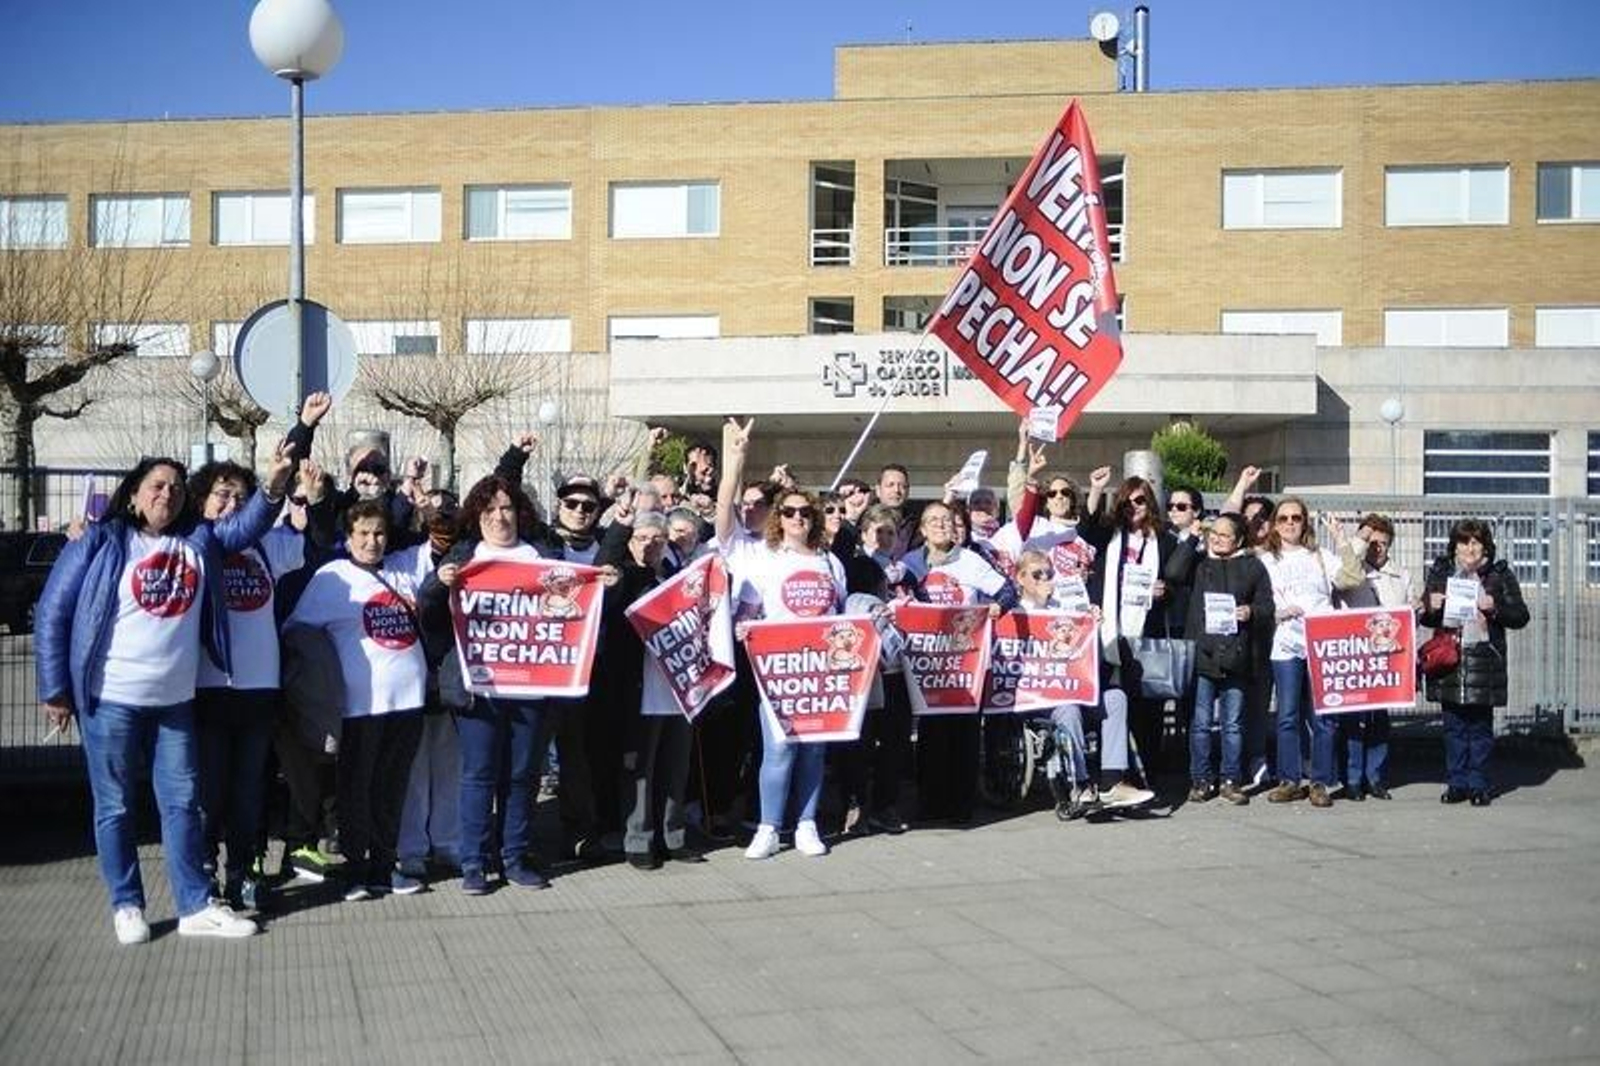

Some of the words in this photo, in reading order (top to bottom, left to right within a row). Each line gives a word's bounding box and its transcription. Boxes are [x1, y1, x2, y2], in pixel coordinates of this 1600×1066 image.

[981, 208, 1072, 311] NON
[1046, 281, 1099, 348] SE
[460, 588, 540, 616] VERÍN
[467, 621, 529, 641] NON
[535, 622, 564, 641] SE
[645, 605, 700, 657] VERÍN
[1313, 634, 1368, 658] VERÍN
[756, 647, 827, 676] VERÍN
[944, 655, 962, 671] SE
[992, 661, 1040, 676] NON
[1044, 662, 1068, 676] SE
[1322, 658, 1365, 675] NON
[1367, 656, 1389, 671] SE
[767, 676, 818, 696] NON
[824, 674, 850, 692] SE
